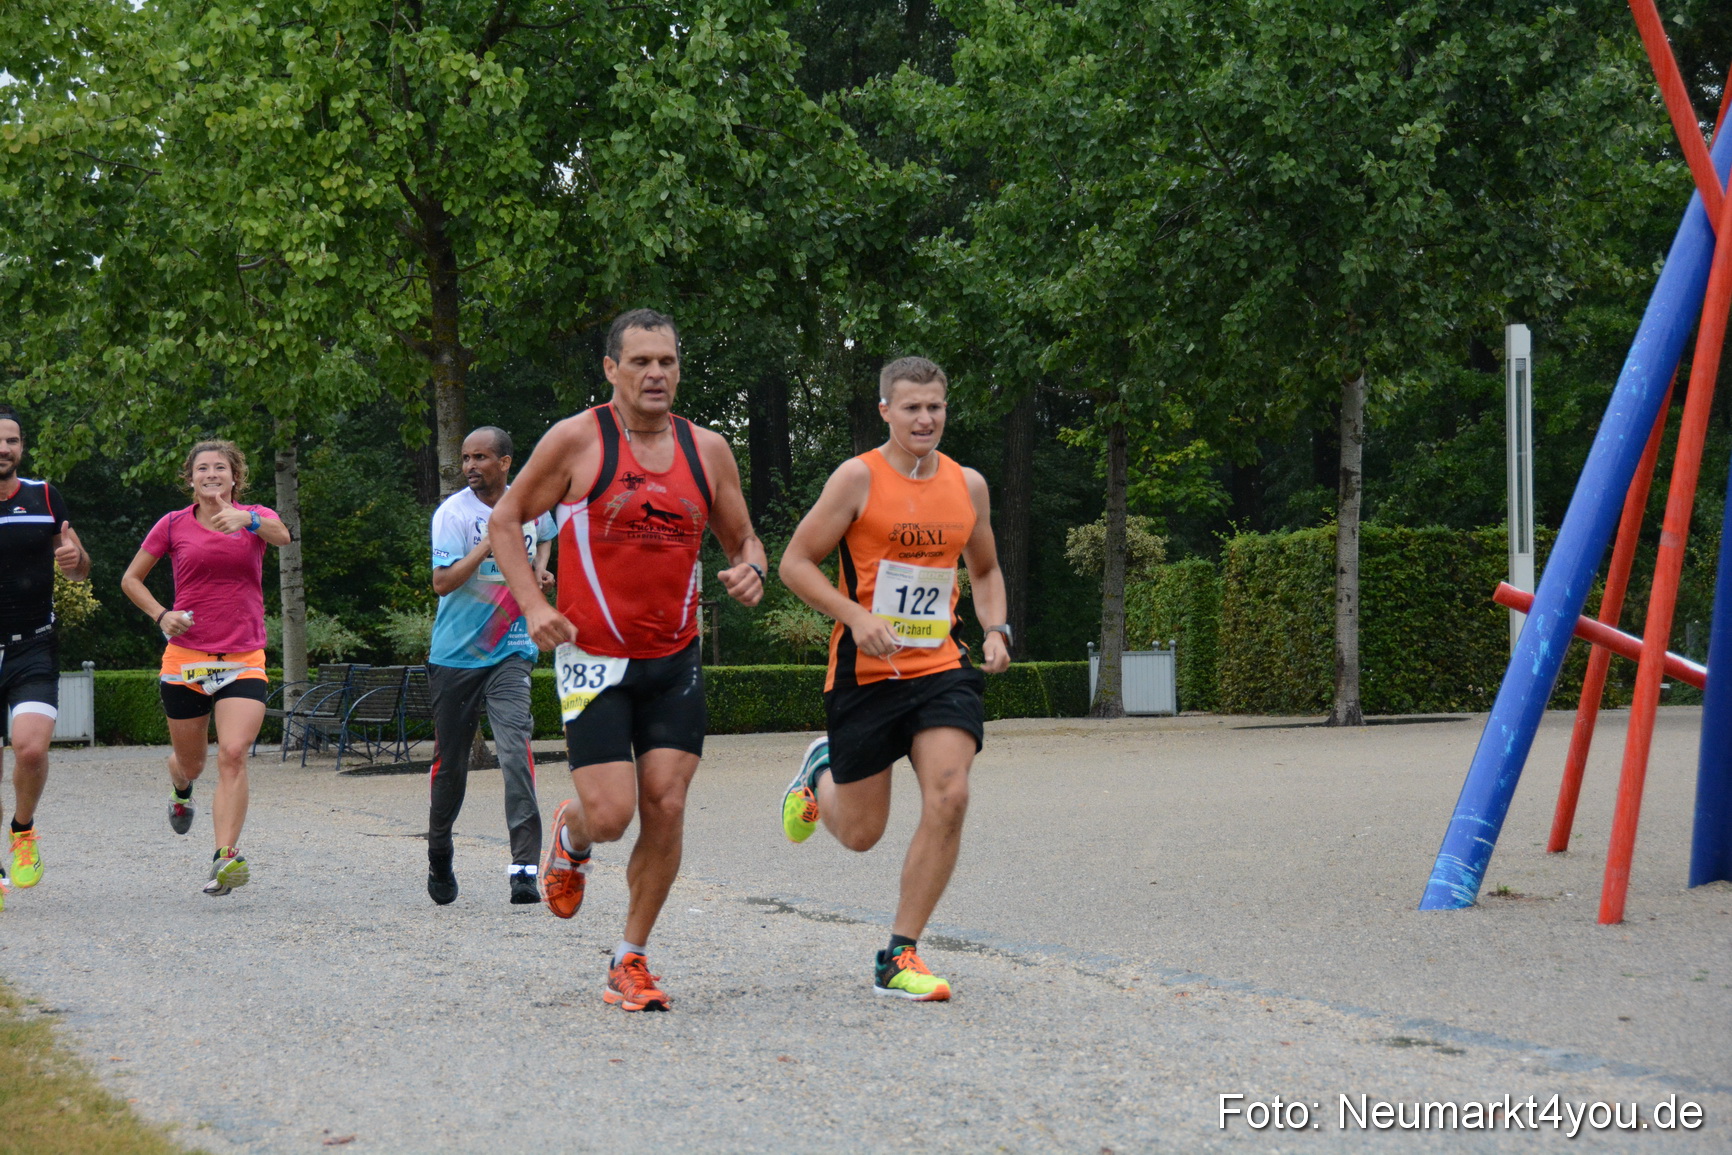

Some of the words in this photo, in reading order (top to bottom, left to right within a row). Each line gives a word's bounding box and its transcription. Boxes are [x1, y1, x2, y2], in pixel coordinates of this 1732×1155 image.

[900, 530, 948, 547] OEXL
[895, 585, 940, 616] 122
[561, 663, 607, 693] 283
